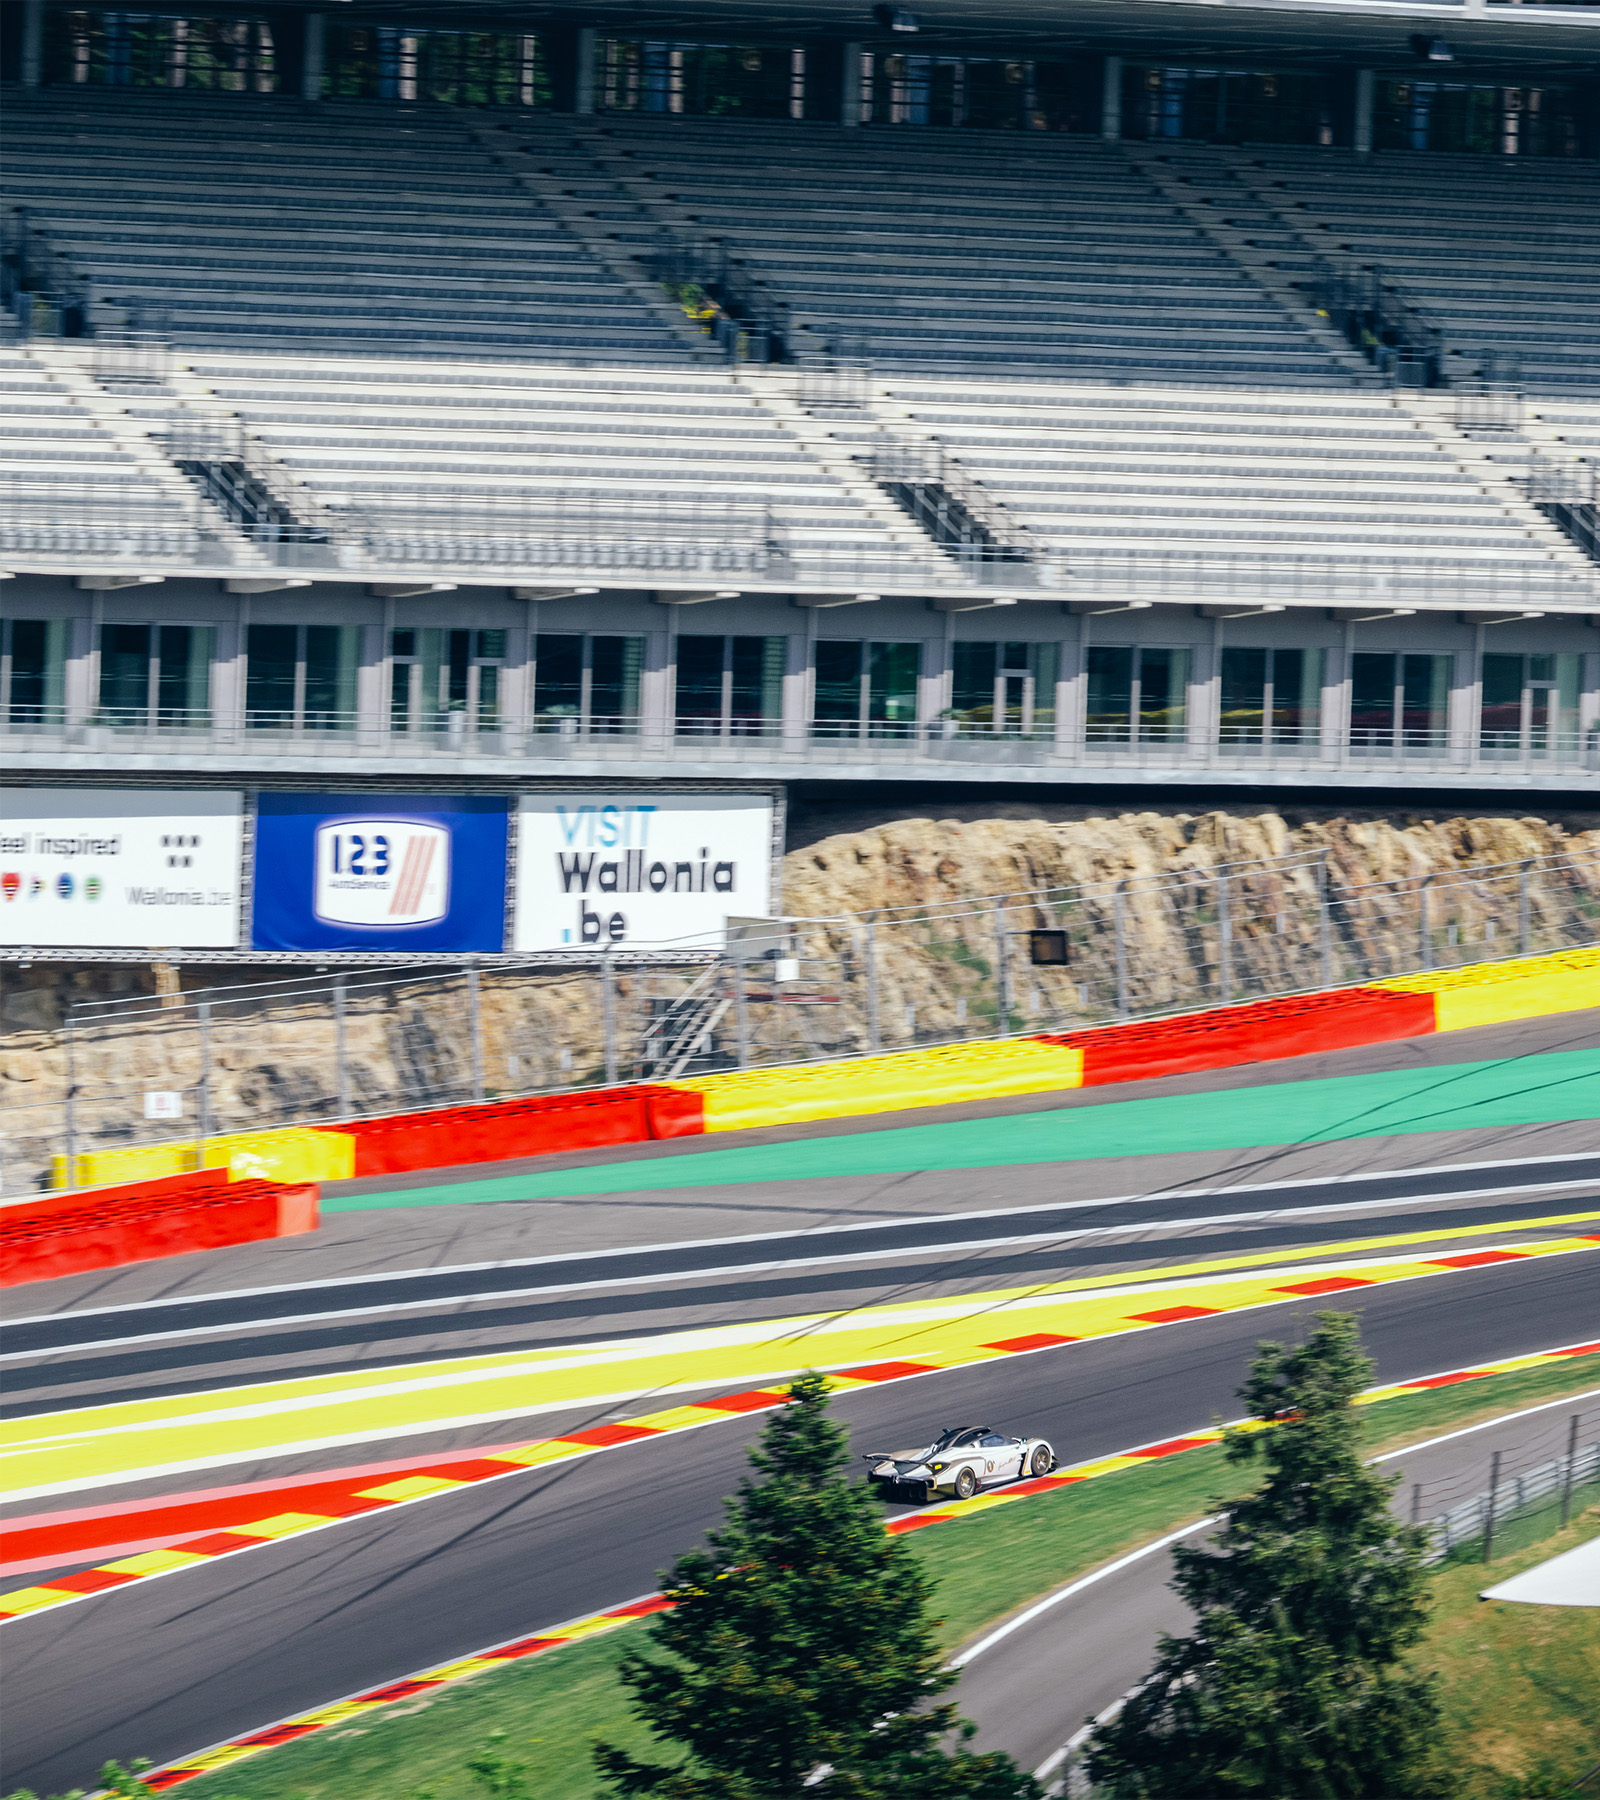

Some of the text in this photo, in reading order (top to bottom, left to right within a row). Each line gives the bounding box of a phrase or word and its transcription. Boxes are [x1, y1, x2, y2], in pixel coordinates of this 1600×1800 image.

[35, 831, 122, 859] inspired
[555, 804, 657, 847] VISIT
[555, 847, 738, 893] Wallonia
